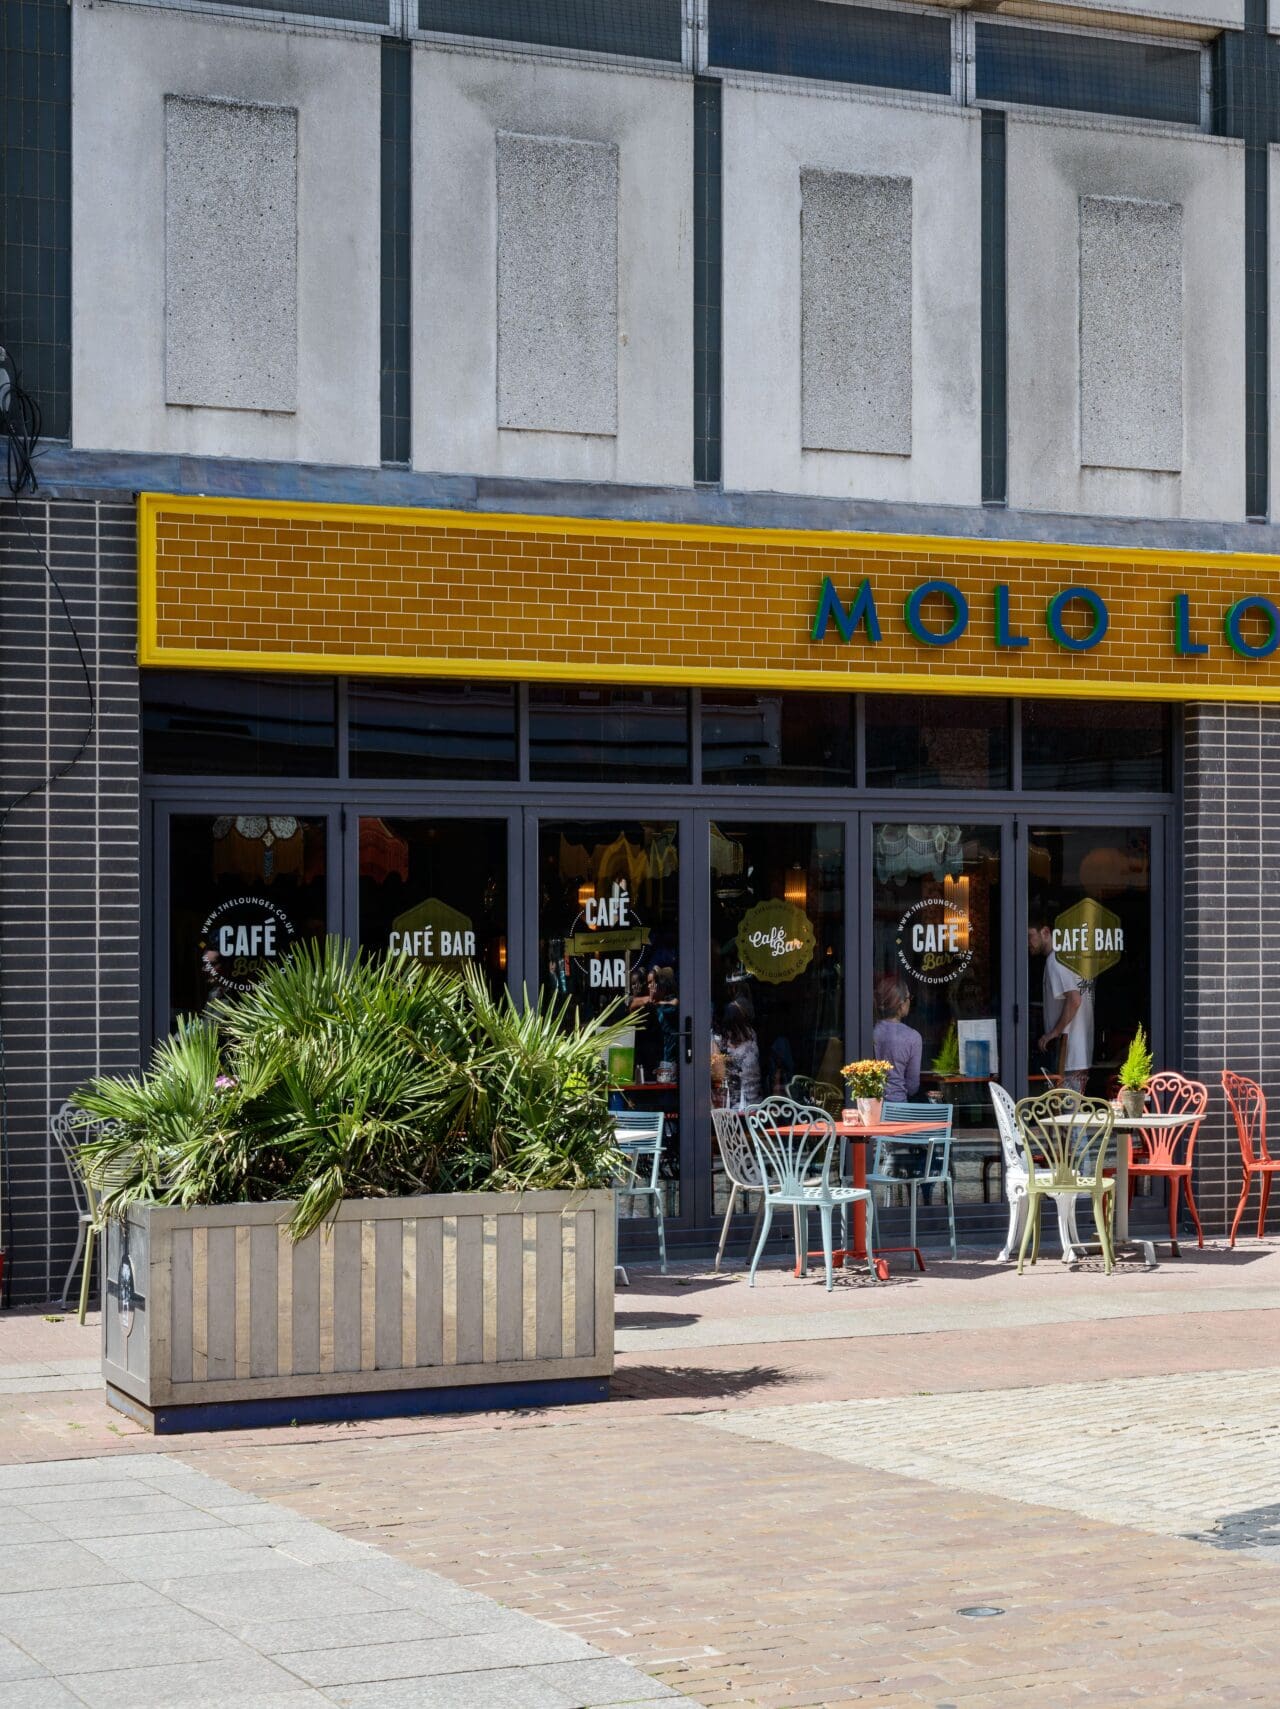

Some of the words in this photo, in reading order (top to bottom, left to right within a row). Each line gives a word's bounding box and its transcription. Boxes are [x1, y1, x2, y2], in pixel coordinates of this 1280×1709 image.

[810, 576, 1109, 651] MOLO
[201, 897, 294, 934] WWW.THELOUNGES.CO.UK
[586, 891, 629, 927] CAFÉ
[898, 899, 974, 933] WWW.THELOUNGES.COUK
[220, 917, 276, 956] CAFÉ
[389, 925, 434, 956] CAFÉ
[441, 931, 475, 956] BAR
[749, 926, 786, 950] Café
[772, 938, 803, 956] Bar
[912, 918, 959, 952] CAFÉ
[1052, 922, 1089, 951] CAFÉ
[1094, 928, 1124, 951] BAR
[590, 959, 626, 987] BAR
[898, 947, 974, 984] WWW.THELOUNGES.CO.UK
[922, 952, 953, 971] Bar
